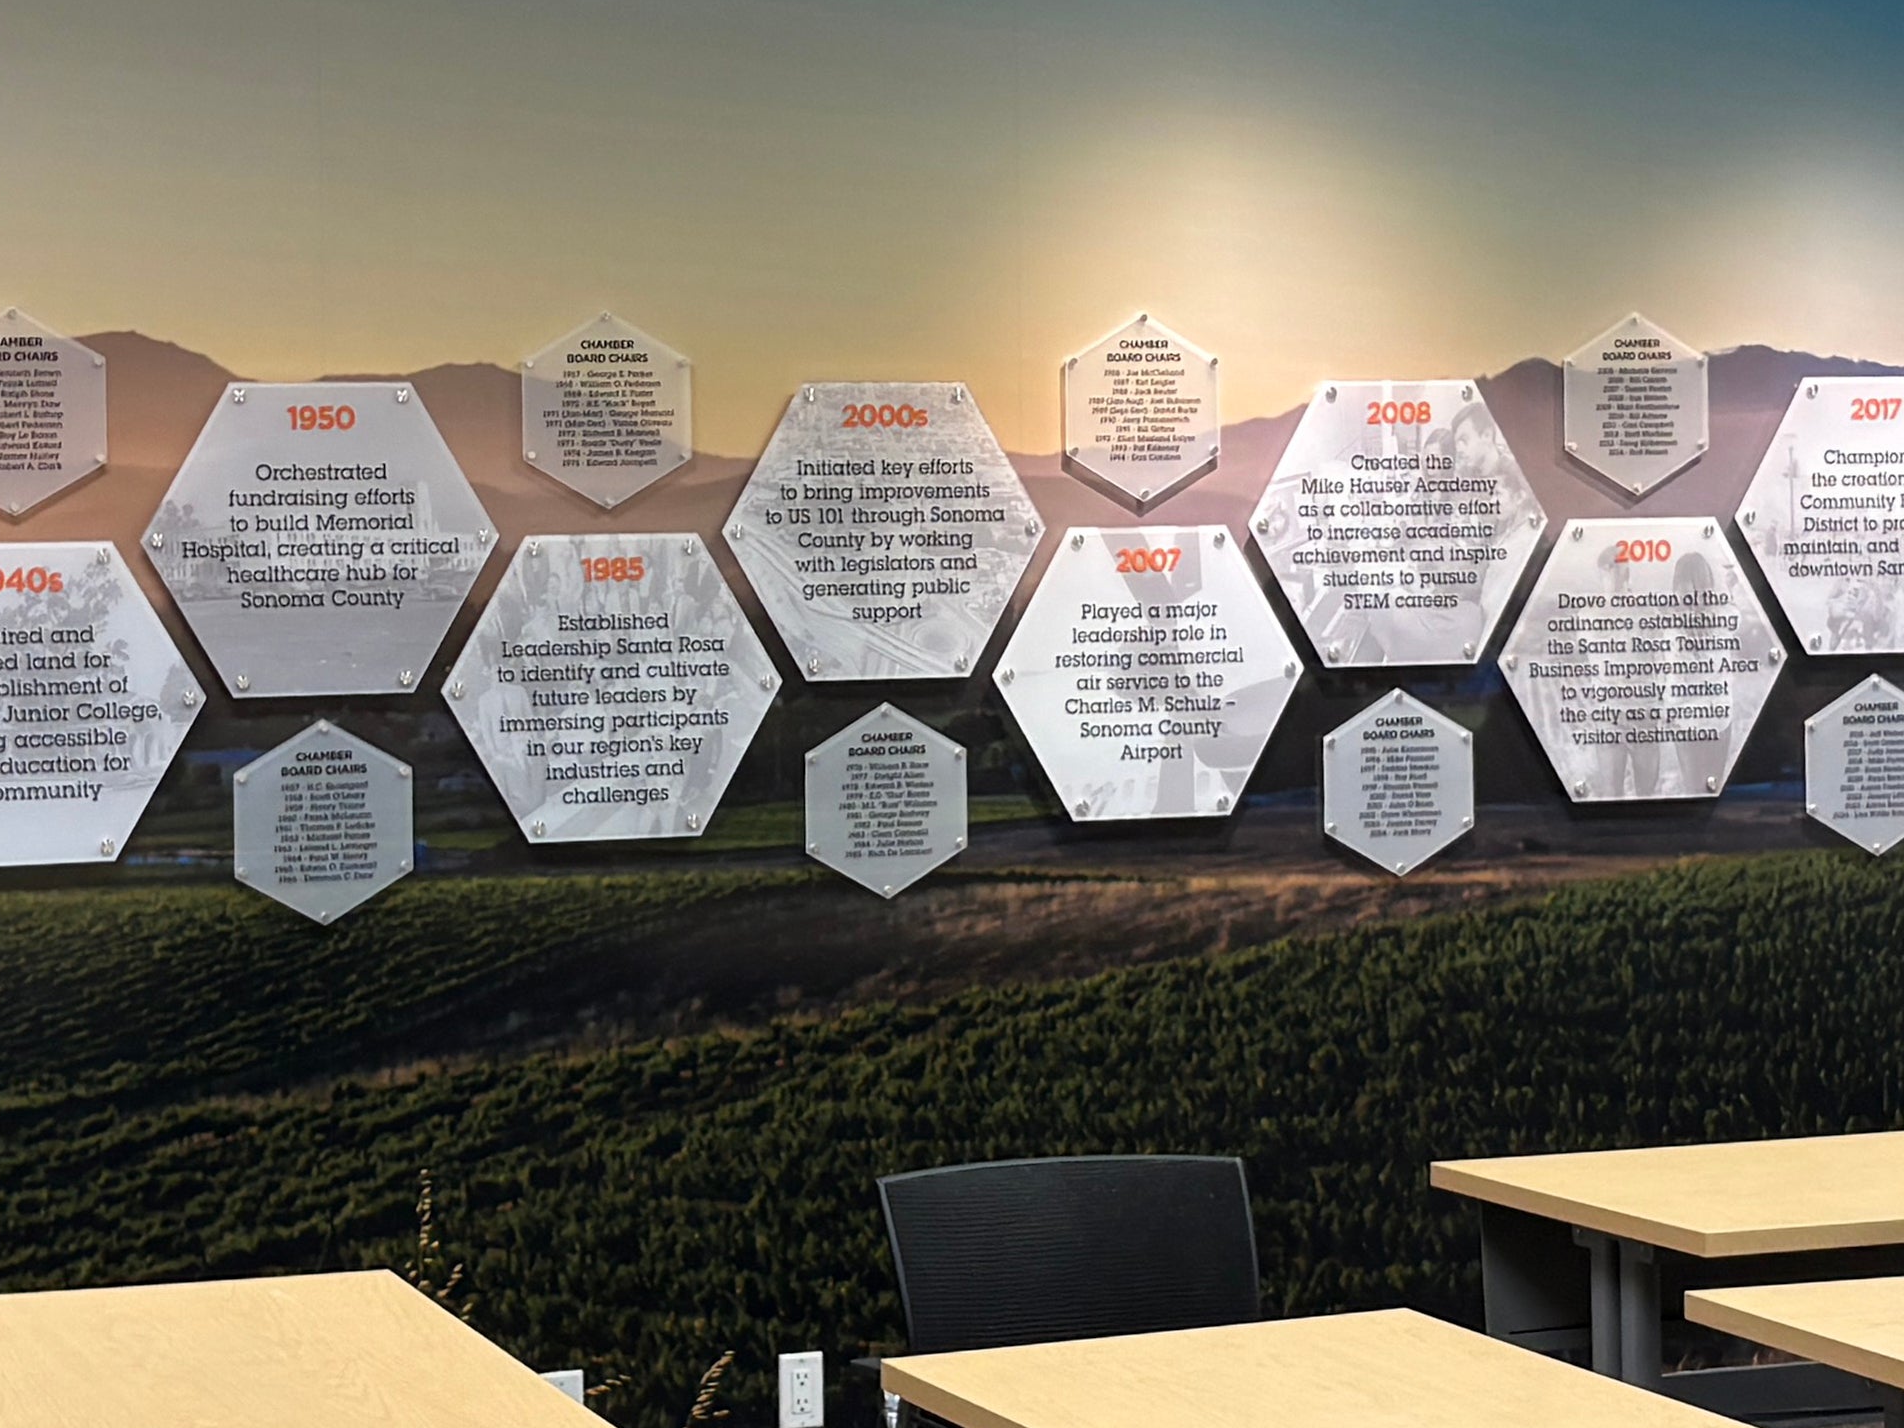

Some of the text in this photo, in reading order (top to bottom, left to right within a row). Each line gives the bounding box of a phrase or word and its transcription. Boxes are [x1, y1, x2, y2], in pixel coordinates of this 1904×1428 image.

[567, 353, 606, 364] BOARD
[287, 405, 356, 431] 1950
[841, 404, 928, 428] 2000s
[1366, 401, 1431, 425] 2008
[1850, 398, 1902, 421] 2017
[254, 463, 388, 480] Orchestrated
[795, 458, 975, 478] Initiated key efforts
[1301, 477, 1498, 496] Mike Hauser Academy
[229, 513, 415, 531] to build Memorial
[764, 506, 1006, 526] to US 101 through Sonoma
[1802, 517, 1858, 532] District
[1862, 517, 1878, 531] to
[1115, 548, 1182, 573] 2007
[1614, 540, 1671, 563] 2010
[581, 557, 645, 582] 1985
[1322, 570, 1478, 587] students to pursue
[1787, 561, 1872, 576] downtown
[240, 589, 405, 610] Sonoma County
[1342, 593, 1459, 608] STEM careers
[557, 613, 670, 630] Established
[851, 602, 923, 622] support
[1080, 601, 1220, 622] Played a major
[50, 624, 95, 642] and
[500, 636, 726, 660] Leadership Santa Rosa
[1560, 681, 1729, 702] to vigorously market
[2, 703, 69, 722] Junior
[76, 701, 163, 725] College,
[1064, 695, 1220, 713] Charles M. Schulz
[1571, 726, 1720, 744] visitor destination
[1120, 743, 1183, 763] Airport
[561, 784, 670, 806] challenges
